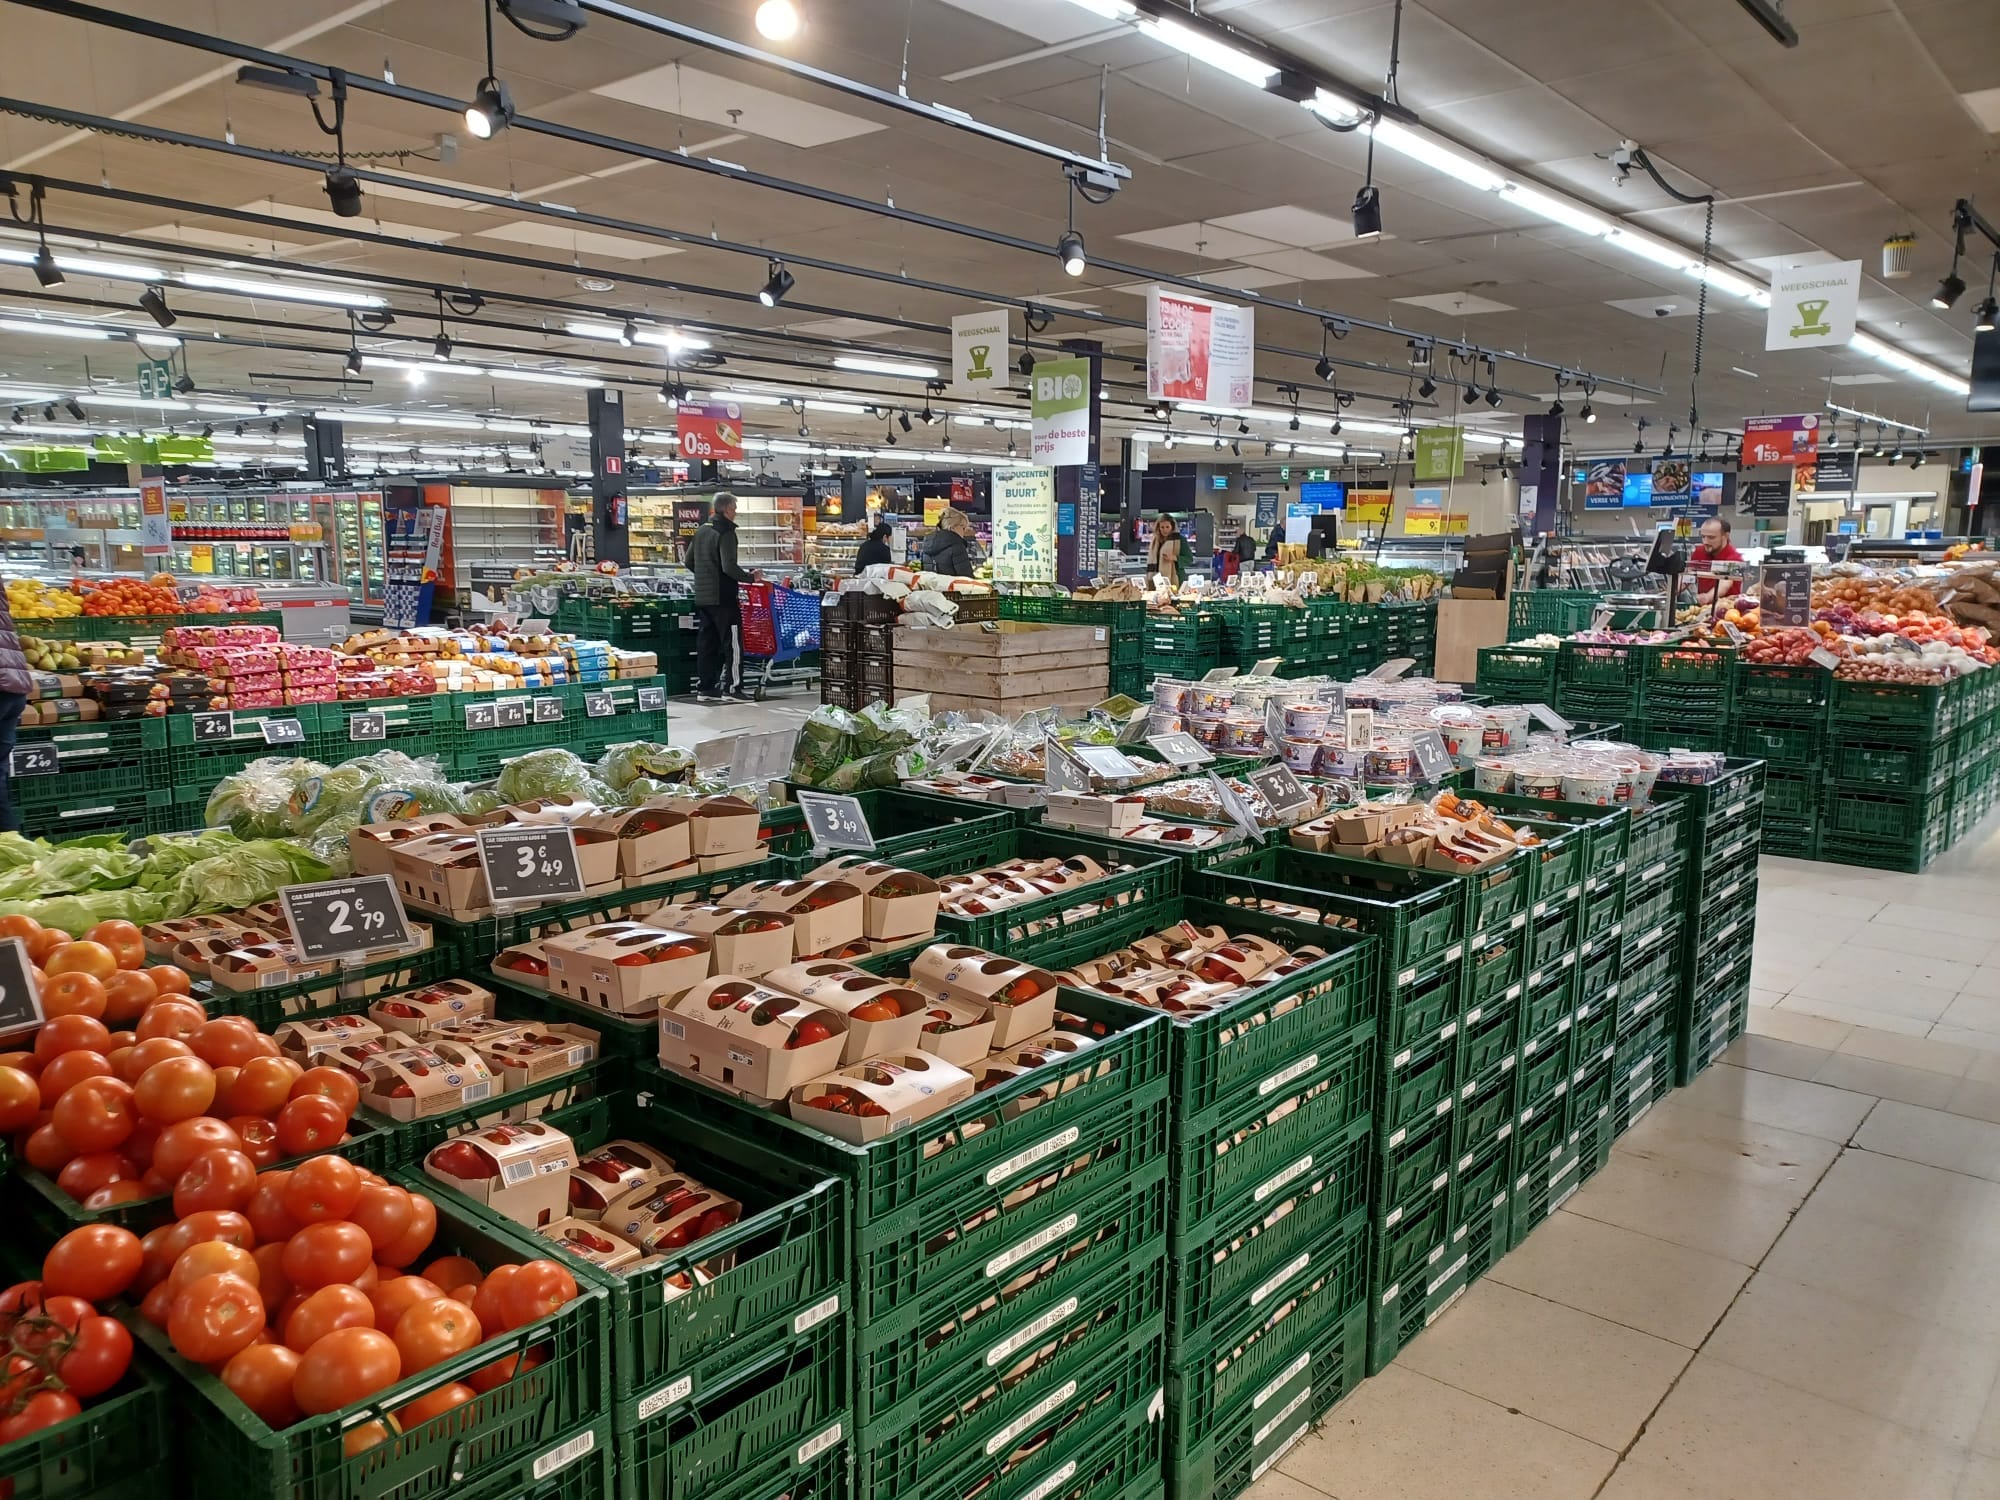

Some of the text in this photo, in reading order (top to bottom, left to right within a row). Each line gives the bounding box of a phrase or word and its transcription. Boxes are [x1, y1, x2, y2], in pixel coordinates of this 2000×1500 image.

[1781, 278, 1848, 292] WEEGSCHAAL
[958, 326, 1001, 337] WEEGSCHAAL
[1037, 374, 1082, 401] BIO
[1048, 430, 1060, 439] de
[1060, 429, 1086, 439] beste
[1034, 442, 1055, 453] prijs
[1005, 488, 1037, 498] BUURT
[679, 510, 700, 518] NEW
[431, 515, 444, 549] Red Bull
